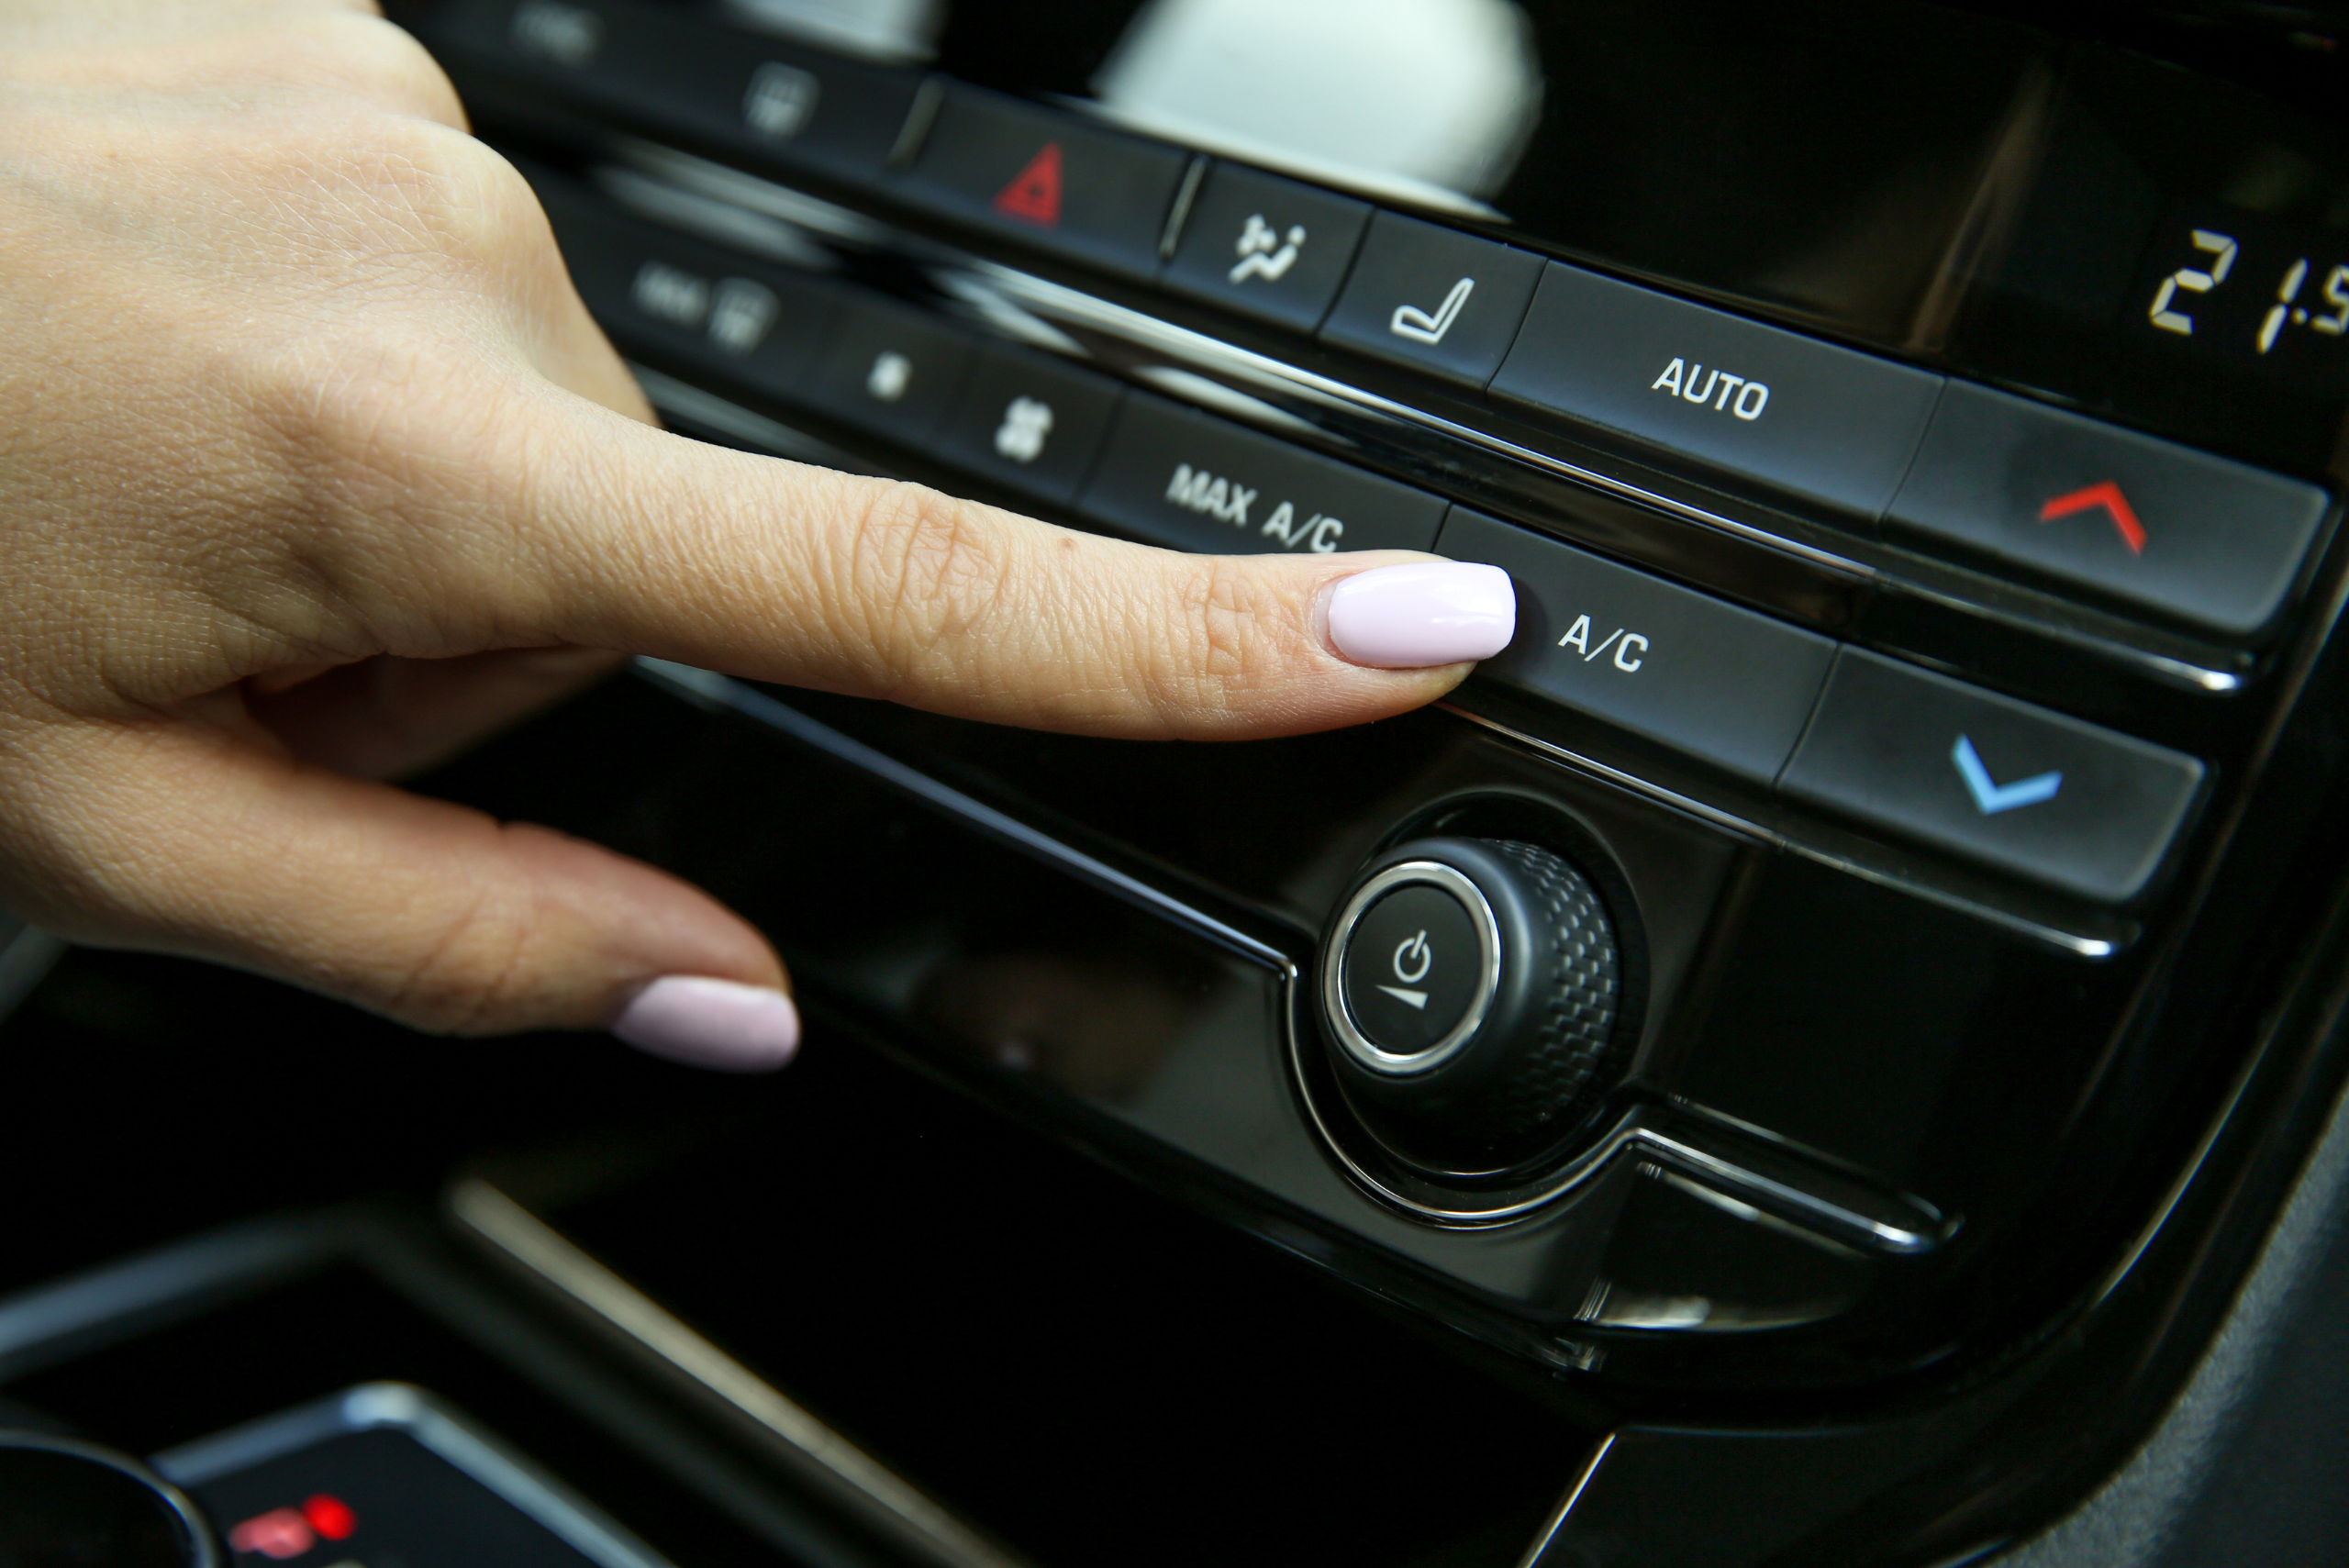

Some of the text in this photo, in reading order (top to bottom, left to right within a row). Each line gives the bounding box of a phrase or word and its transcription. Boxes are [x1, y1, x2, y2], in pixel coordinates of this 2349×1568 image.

[1651, 357, 1770, 421] AUTO
[1165, 462, 1344, 554] MAX A/C
[1557, 614, 1650, 673] A/C
